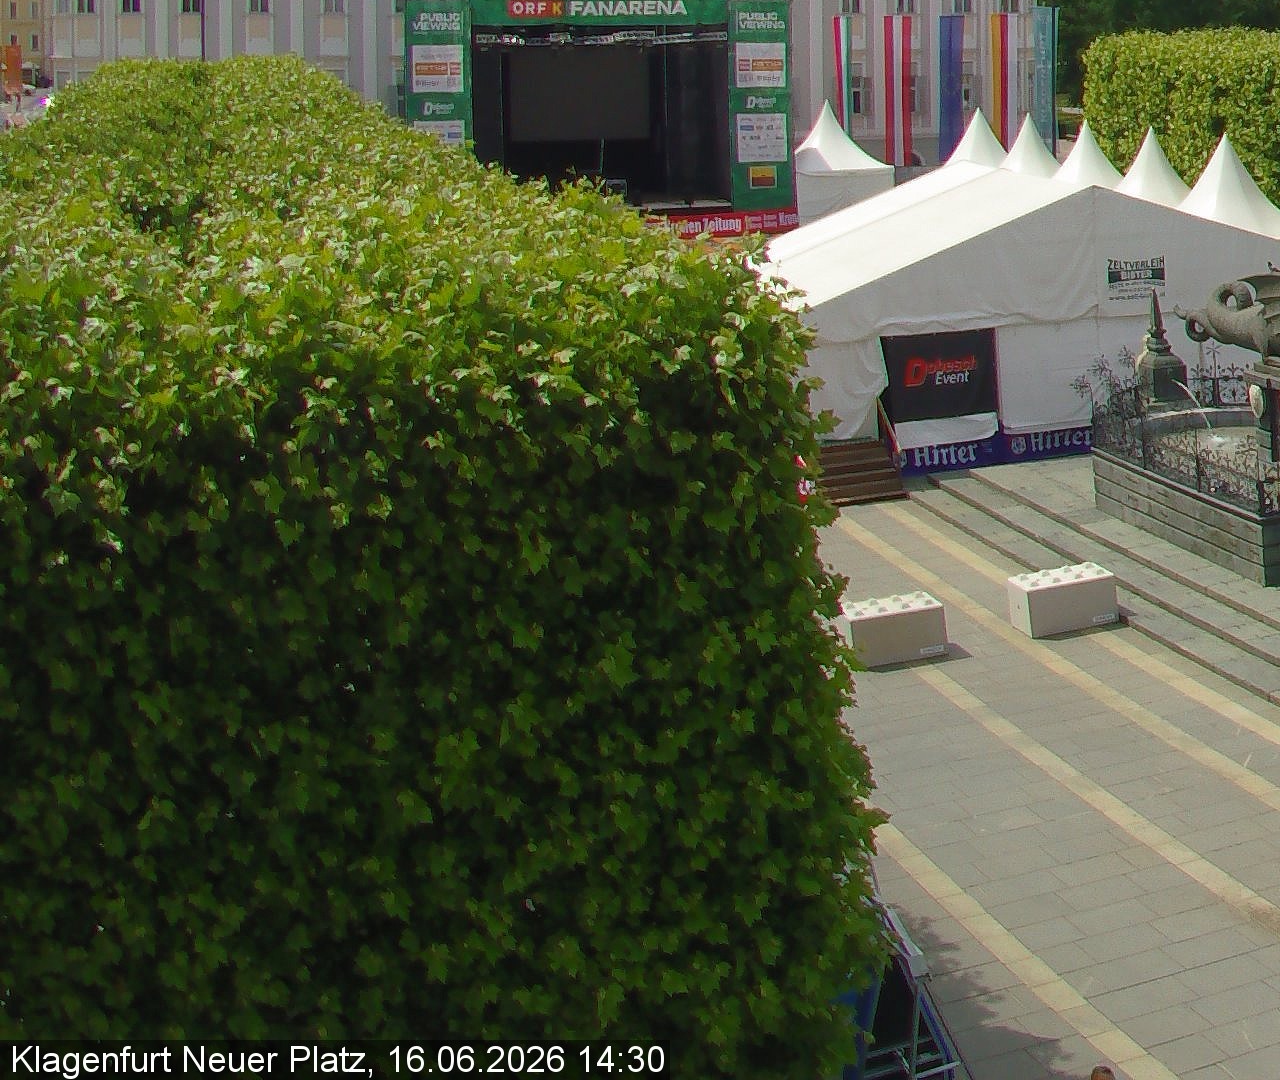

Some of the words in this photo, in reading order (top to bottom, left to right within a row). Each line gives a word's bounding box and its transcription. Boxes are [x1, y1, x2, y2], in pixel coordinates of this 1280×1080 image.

[512, 2, 547, 15] ORF
[552, 1, 563, 16] K
[569, 0, 688, 16] FANARENA
[420, 13, 461, 22] PUBLIC
[739, 12, 778, 21] PUBLIC
[412, 22, 461, 31] VIEWING
[739, 21, 786, 30] VIEWING
[702, 216, 742, 232] Zeitung
[935, 370, 970, 385] Event
[1031, 428, 1094, 453] Hirter
[914, 443, 978, 467] Hirter
